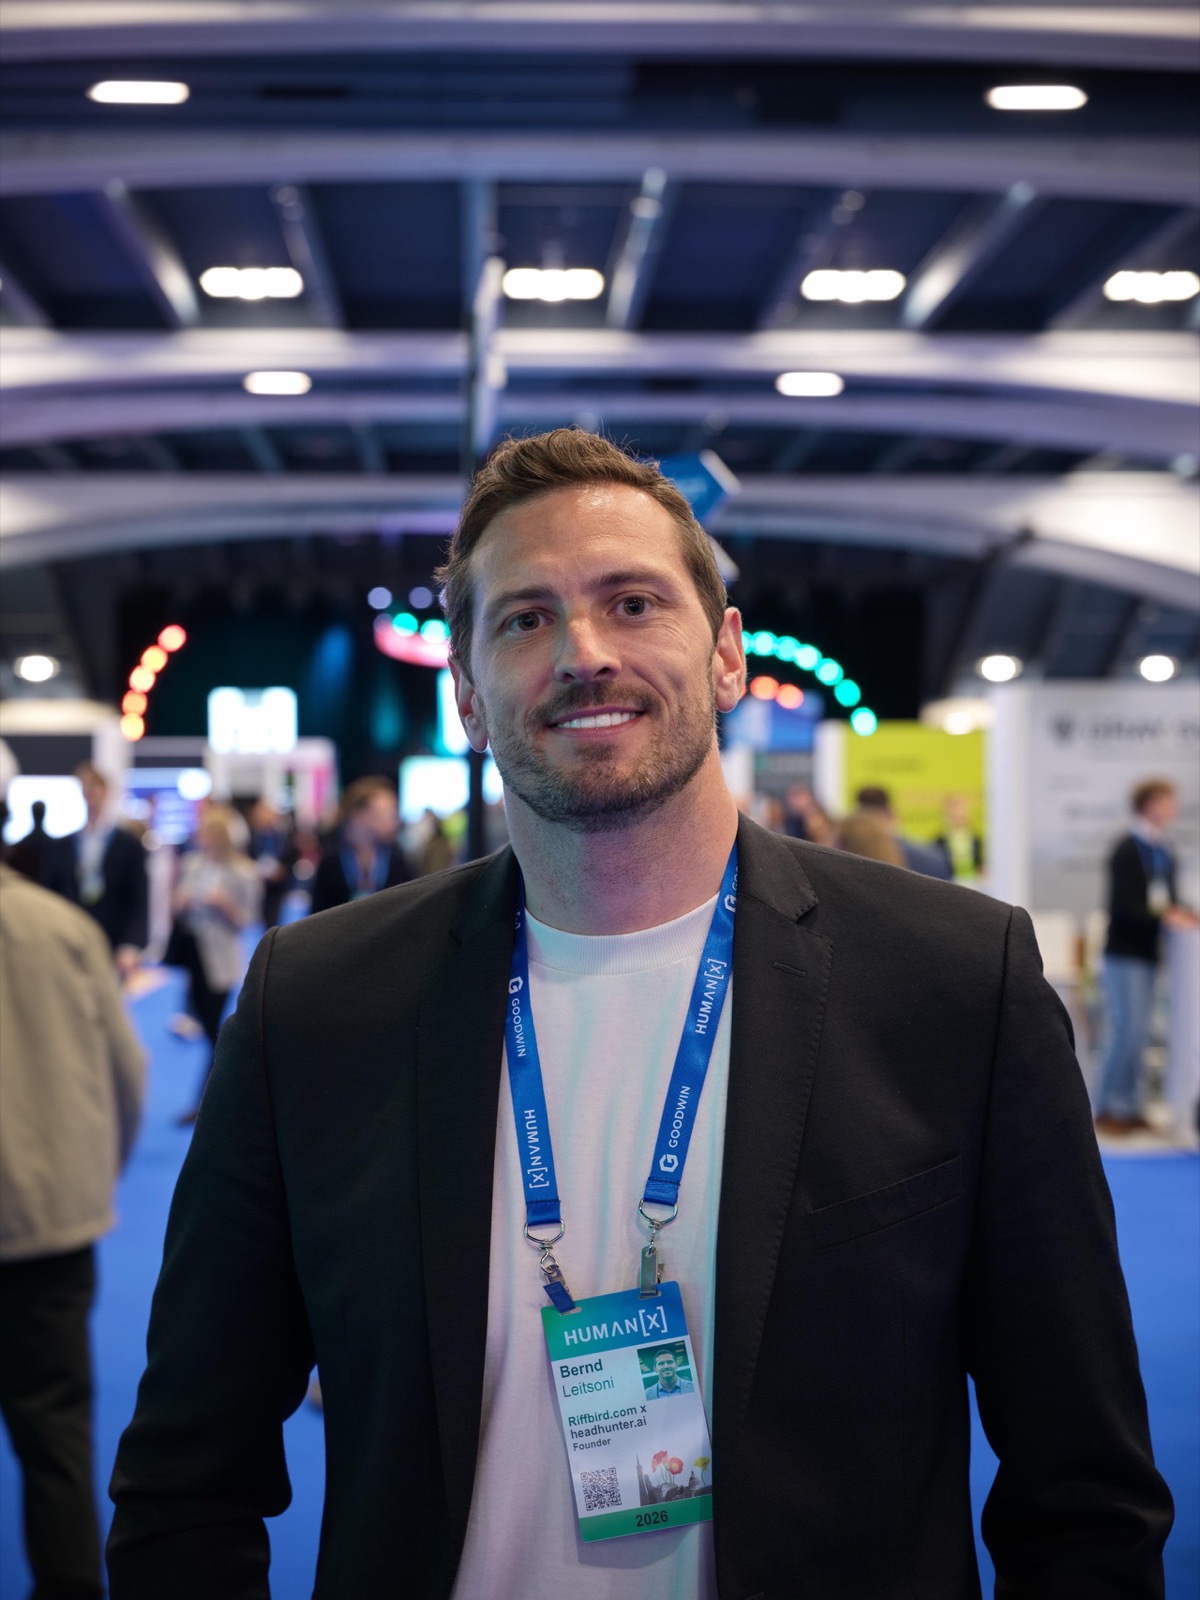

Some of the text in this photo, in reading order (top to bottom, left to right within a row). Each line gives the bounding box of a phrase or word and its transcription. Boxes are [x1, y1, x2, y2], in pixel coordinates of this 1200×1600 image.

[695, 958, 727, 1035] HUMAN[X]
[511, 998, 526, 1058] GOODWIN
[668, 1085, 691, 1148] GOODWIN
[523, 1109, 550, 1189] HUMAN[X]
[564, 1306, 669, 1346] HUMAN[X]
[559, 1358, 604, 1379] Bernd
[562, 1376, 615, 1398] Leitsoni
[568, 1405, 648, 1427] Riffbird.com x
[570, 1416, 647, 1440] headhunter.ai
[573, 1438, 611, 1451] Founder
[635, 1510, 669, 1527] 2026
